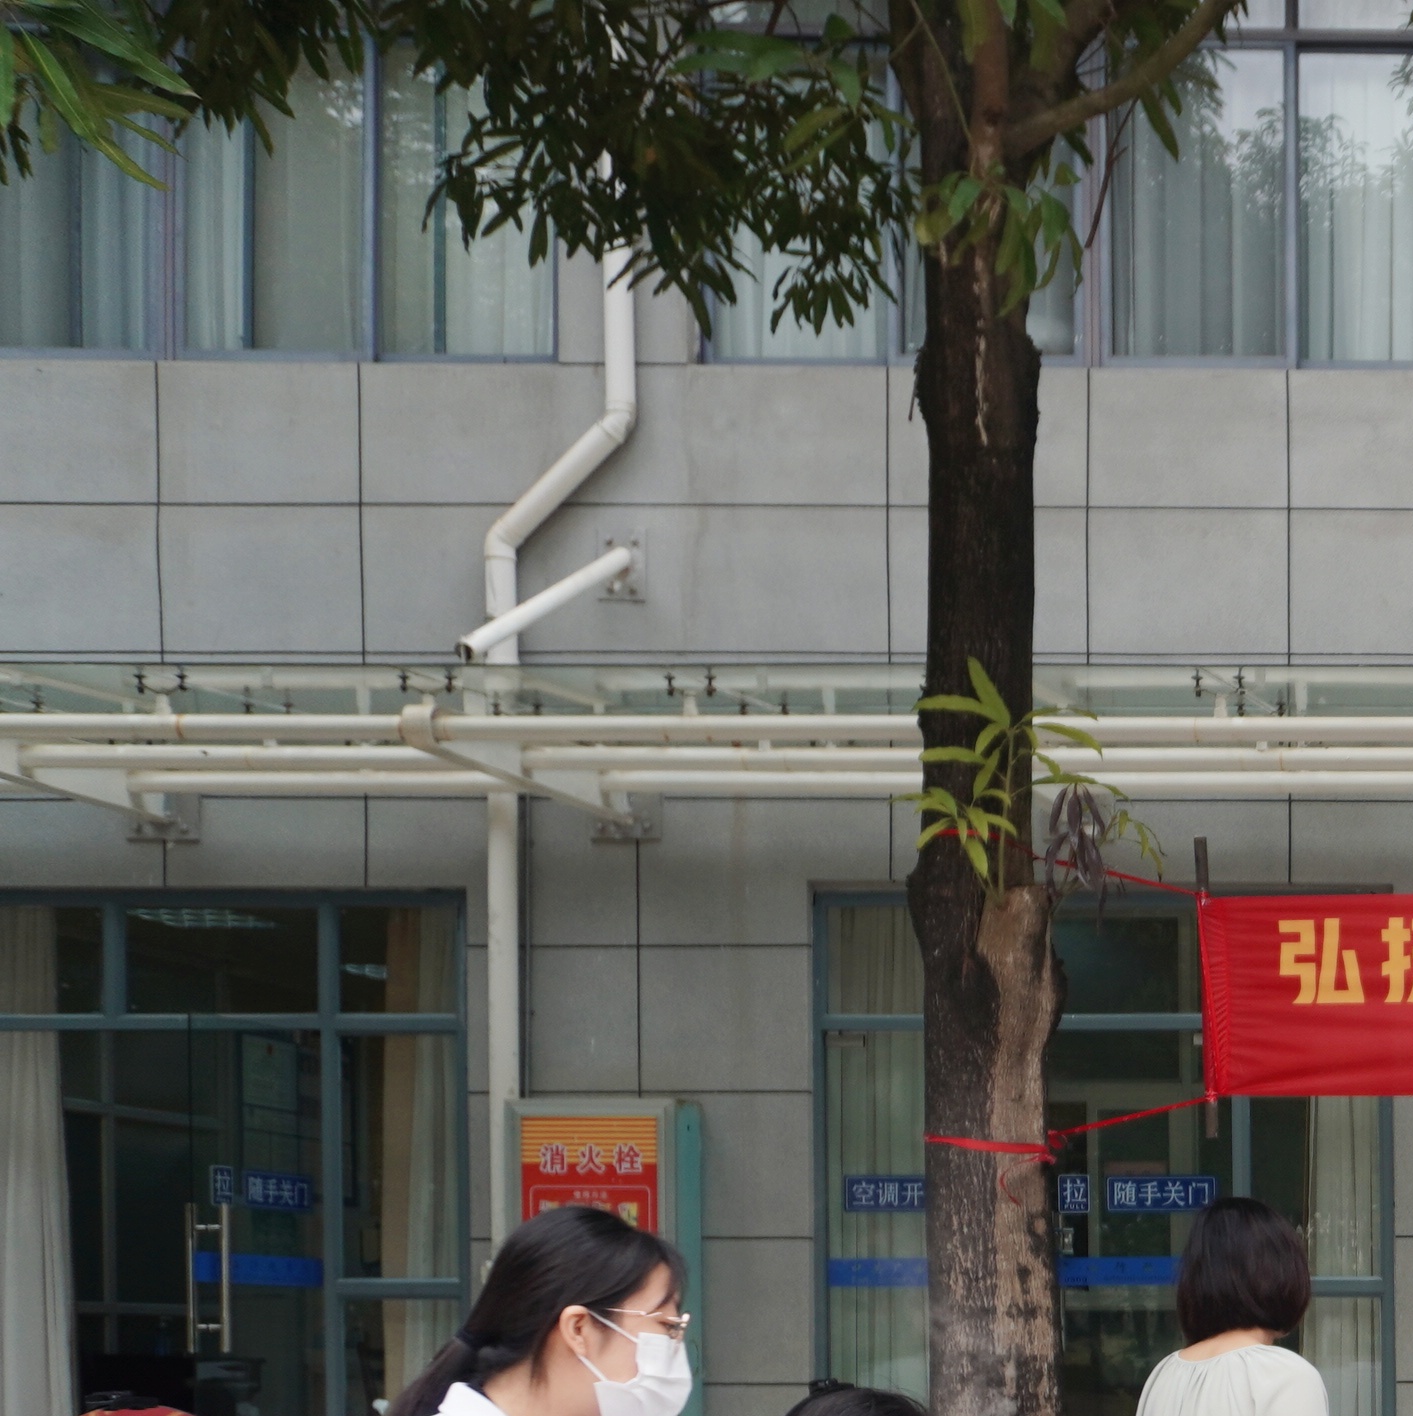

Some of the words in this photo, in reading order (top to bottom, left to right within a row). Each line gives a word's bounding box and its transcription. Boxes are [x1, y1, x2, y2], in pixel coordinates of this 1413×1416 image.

[540, 1144, 642, 1174] 消火栓
[215, 1171, 231, 1196] 拉
[248, 1177, 308, 1206] 随手关门
[1063, 1178, 1087, 1204] 拉
[1113, 1181, 1209, 1206] 随手关门
